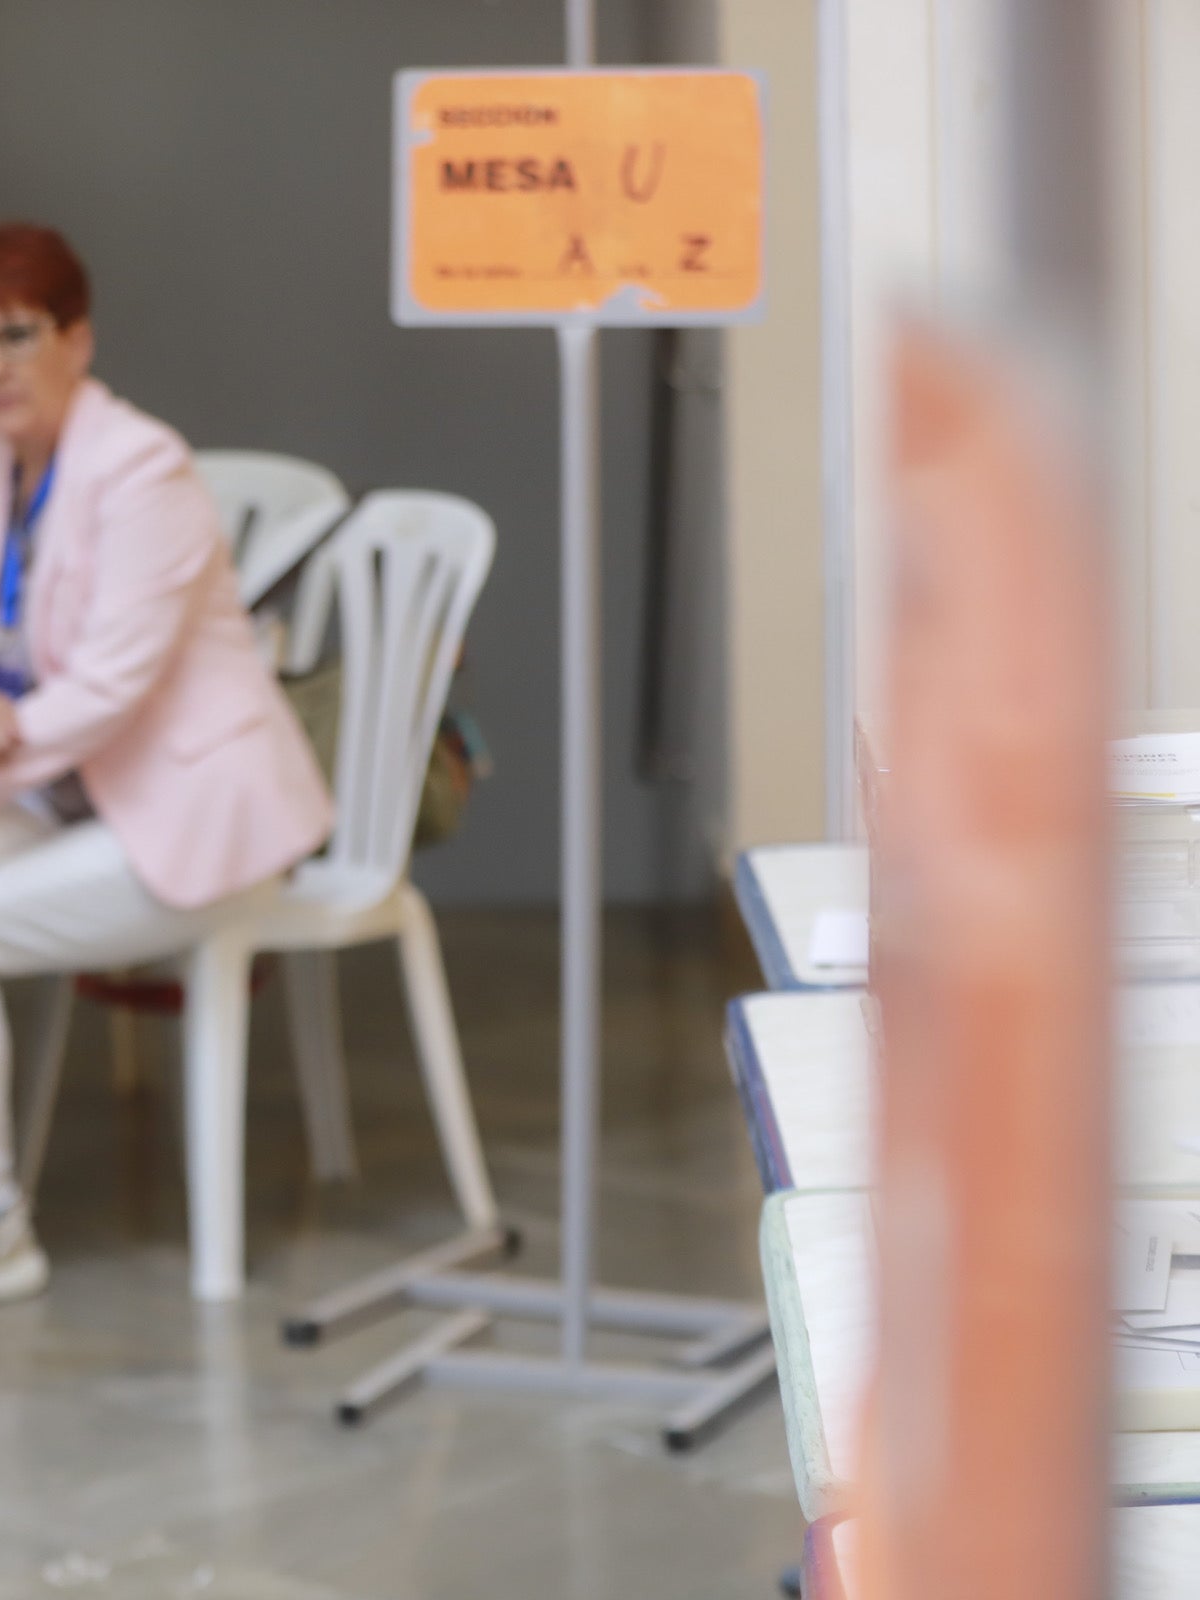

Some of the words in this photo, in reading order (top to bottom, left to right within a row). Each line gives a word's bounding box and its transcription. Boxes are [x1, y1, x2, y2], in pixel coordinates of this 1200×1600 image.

[439, 157, 578, 193] MESA
[557, 233, 598, 279] A
[680, 234, 712, 275] Z
